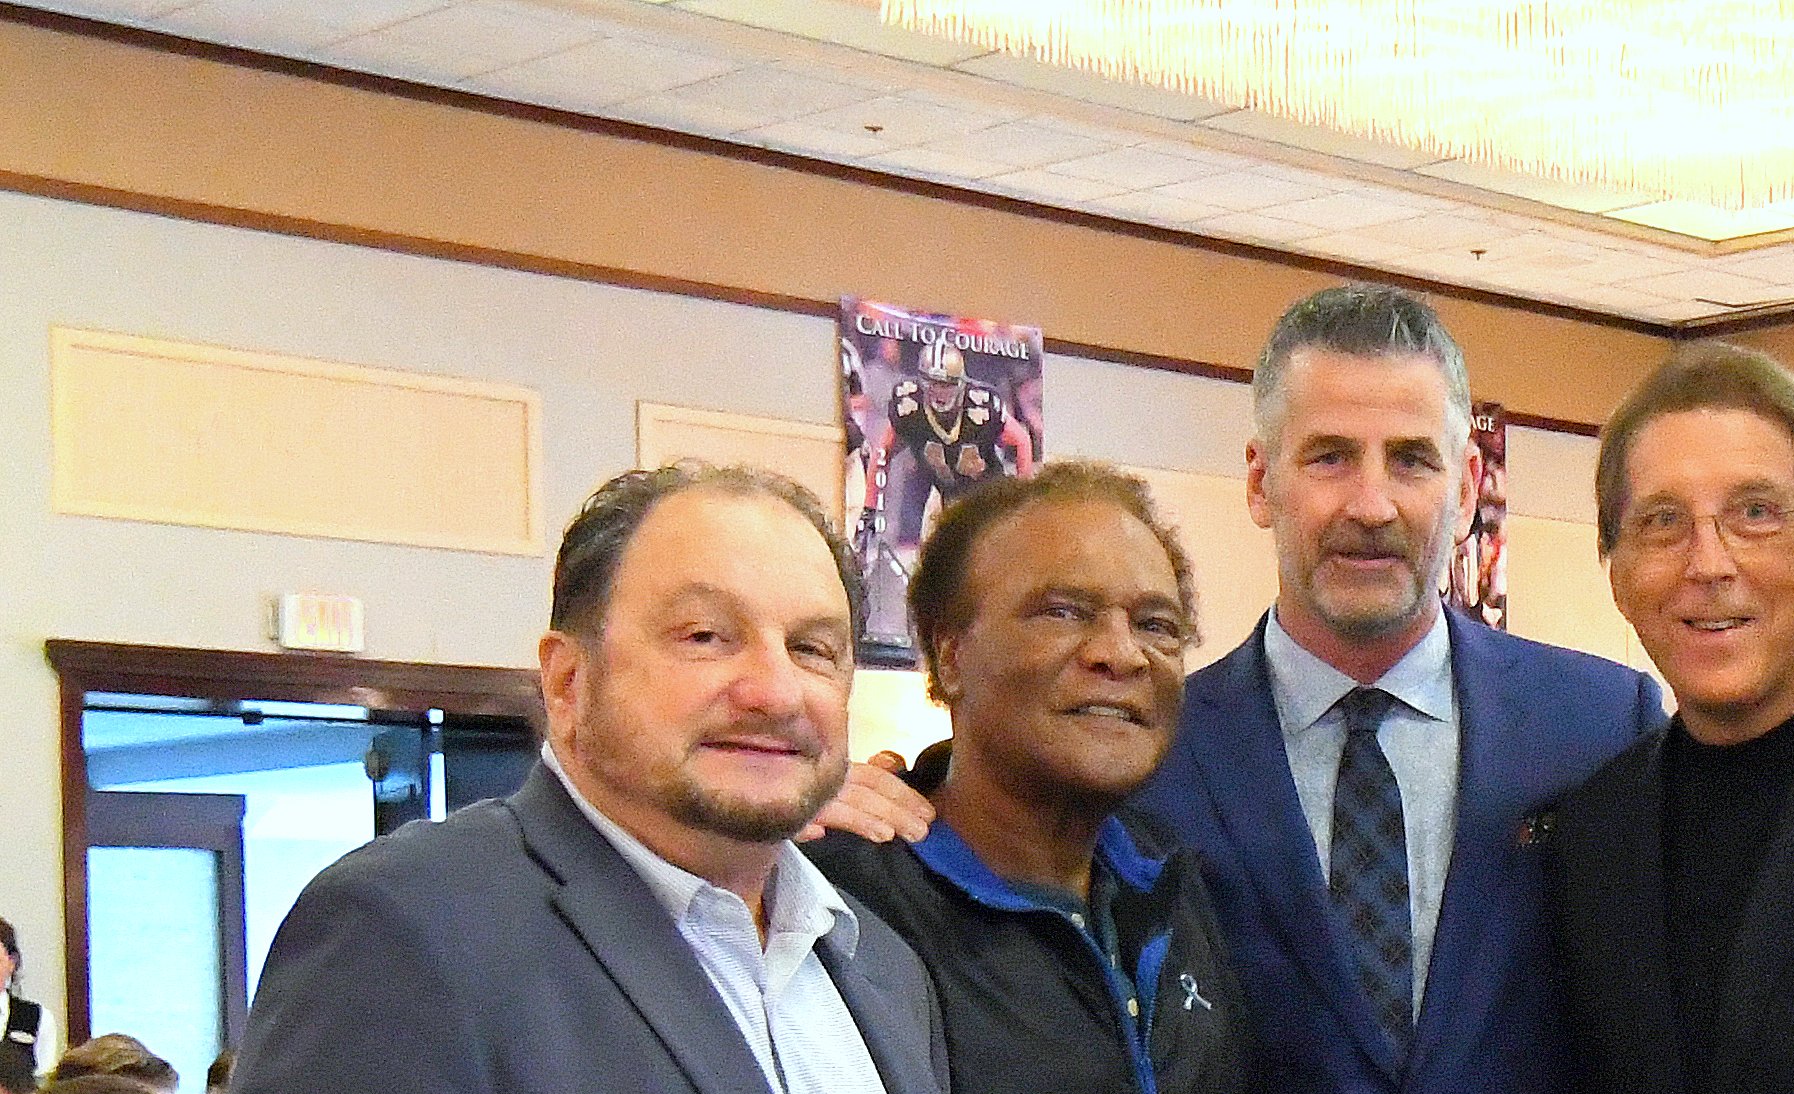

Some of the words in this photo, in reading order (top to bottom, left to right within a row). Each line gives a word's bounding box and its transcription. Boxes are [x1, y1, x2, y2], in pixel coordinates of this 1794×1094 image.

[856, 313, 903, 340] CALL
[909, 321, 936, 344] TO
[941, 327, 1030, 360] COURAGE
